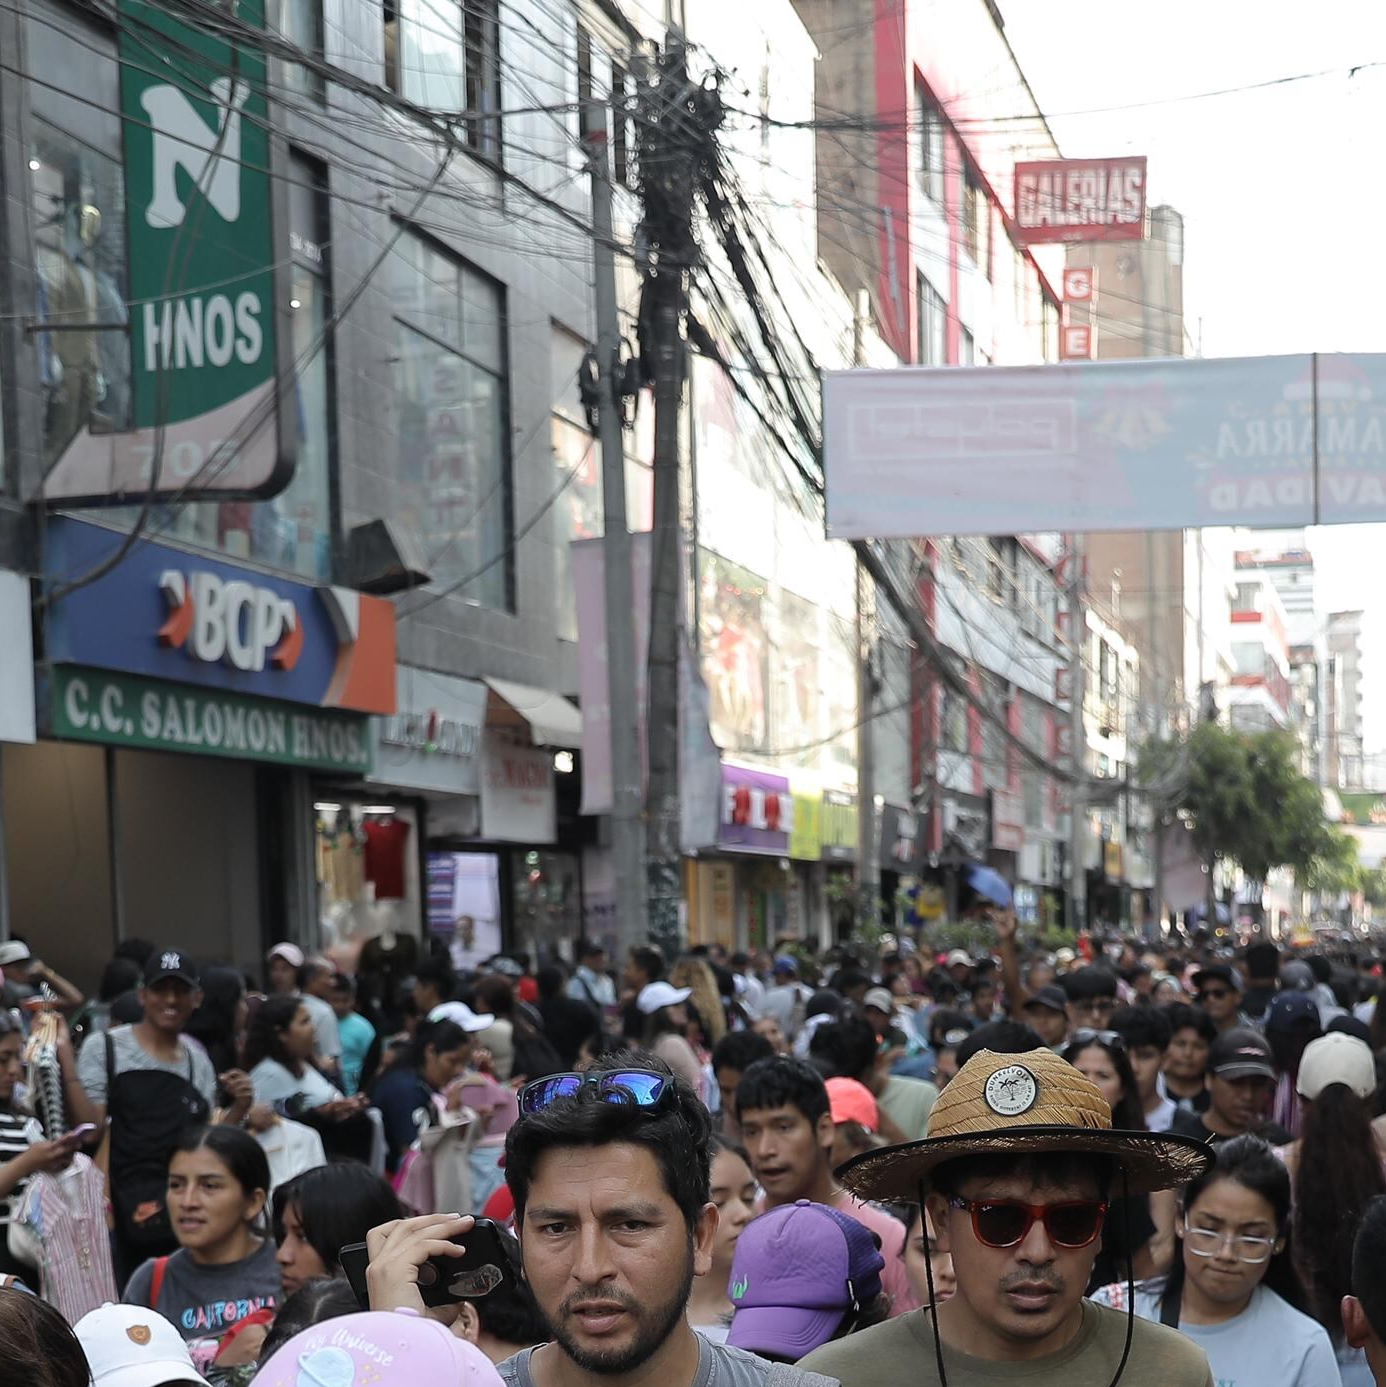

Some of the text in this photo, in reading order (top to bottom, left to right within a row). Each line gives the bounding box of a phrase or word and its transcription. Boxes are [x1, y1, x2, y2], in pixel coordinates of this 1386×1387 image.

[1018, 167, 1143, 229] GALERIAS
[143, 291, 263, 372] HNOS
[190, 572, 284, 671] BCP
[140, 690, 287, 755] SALOMON
